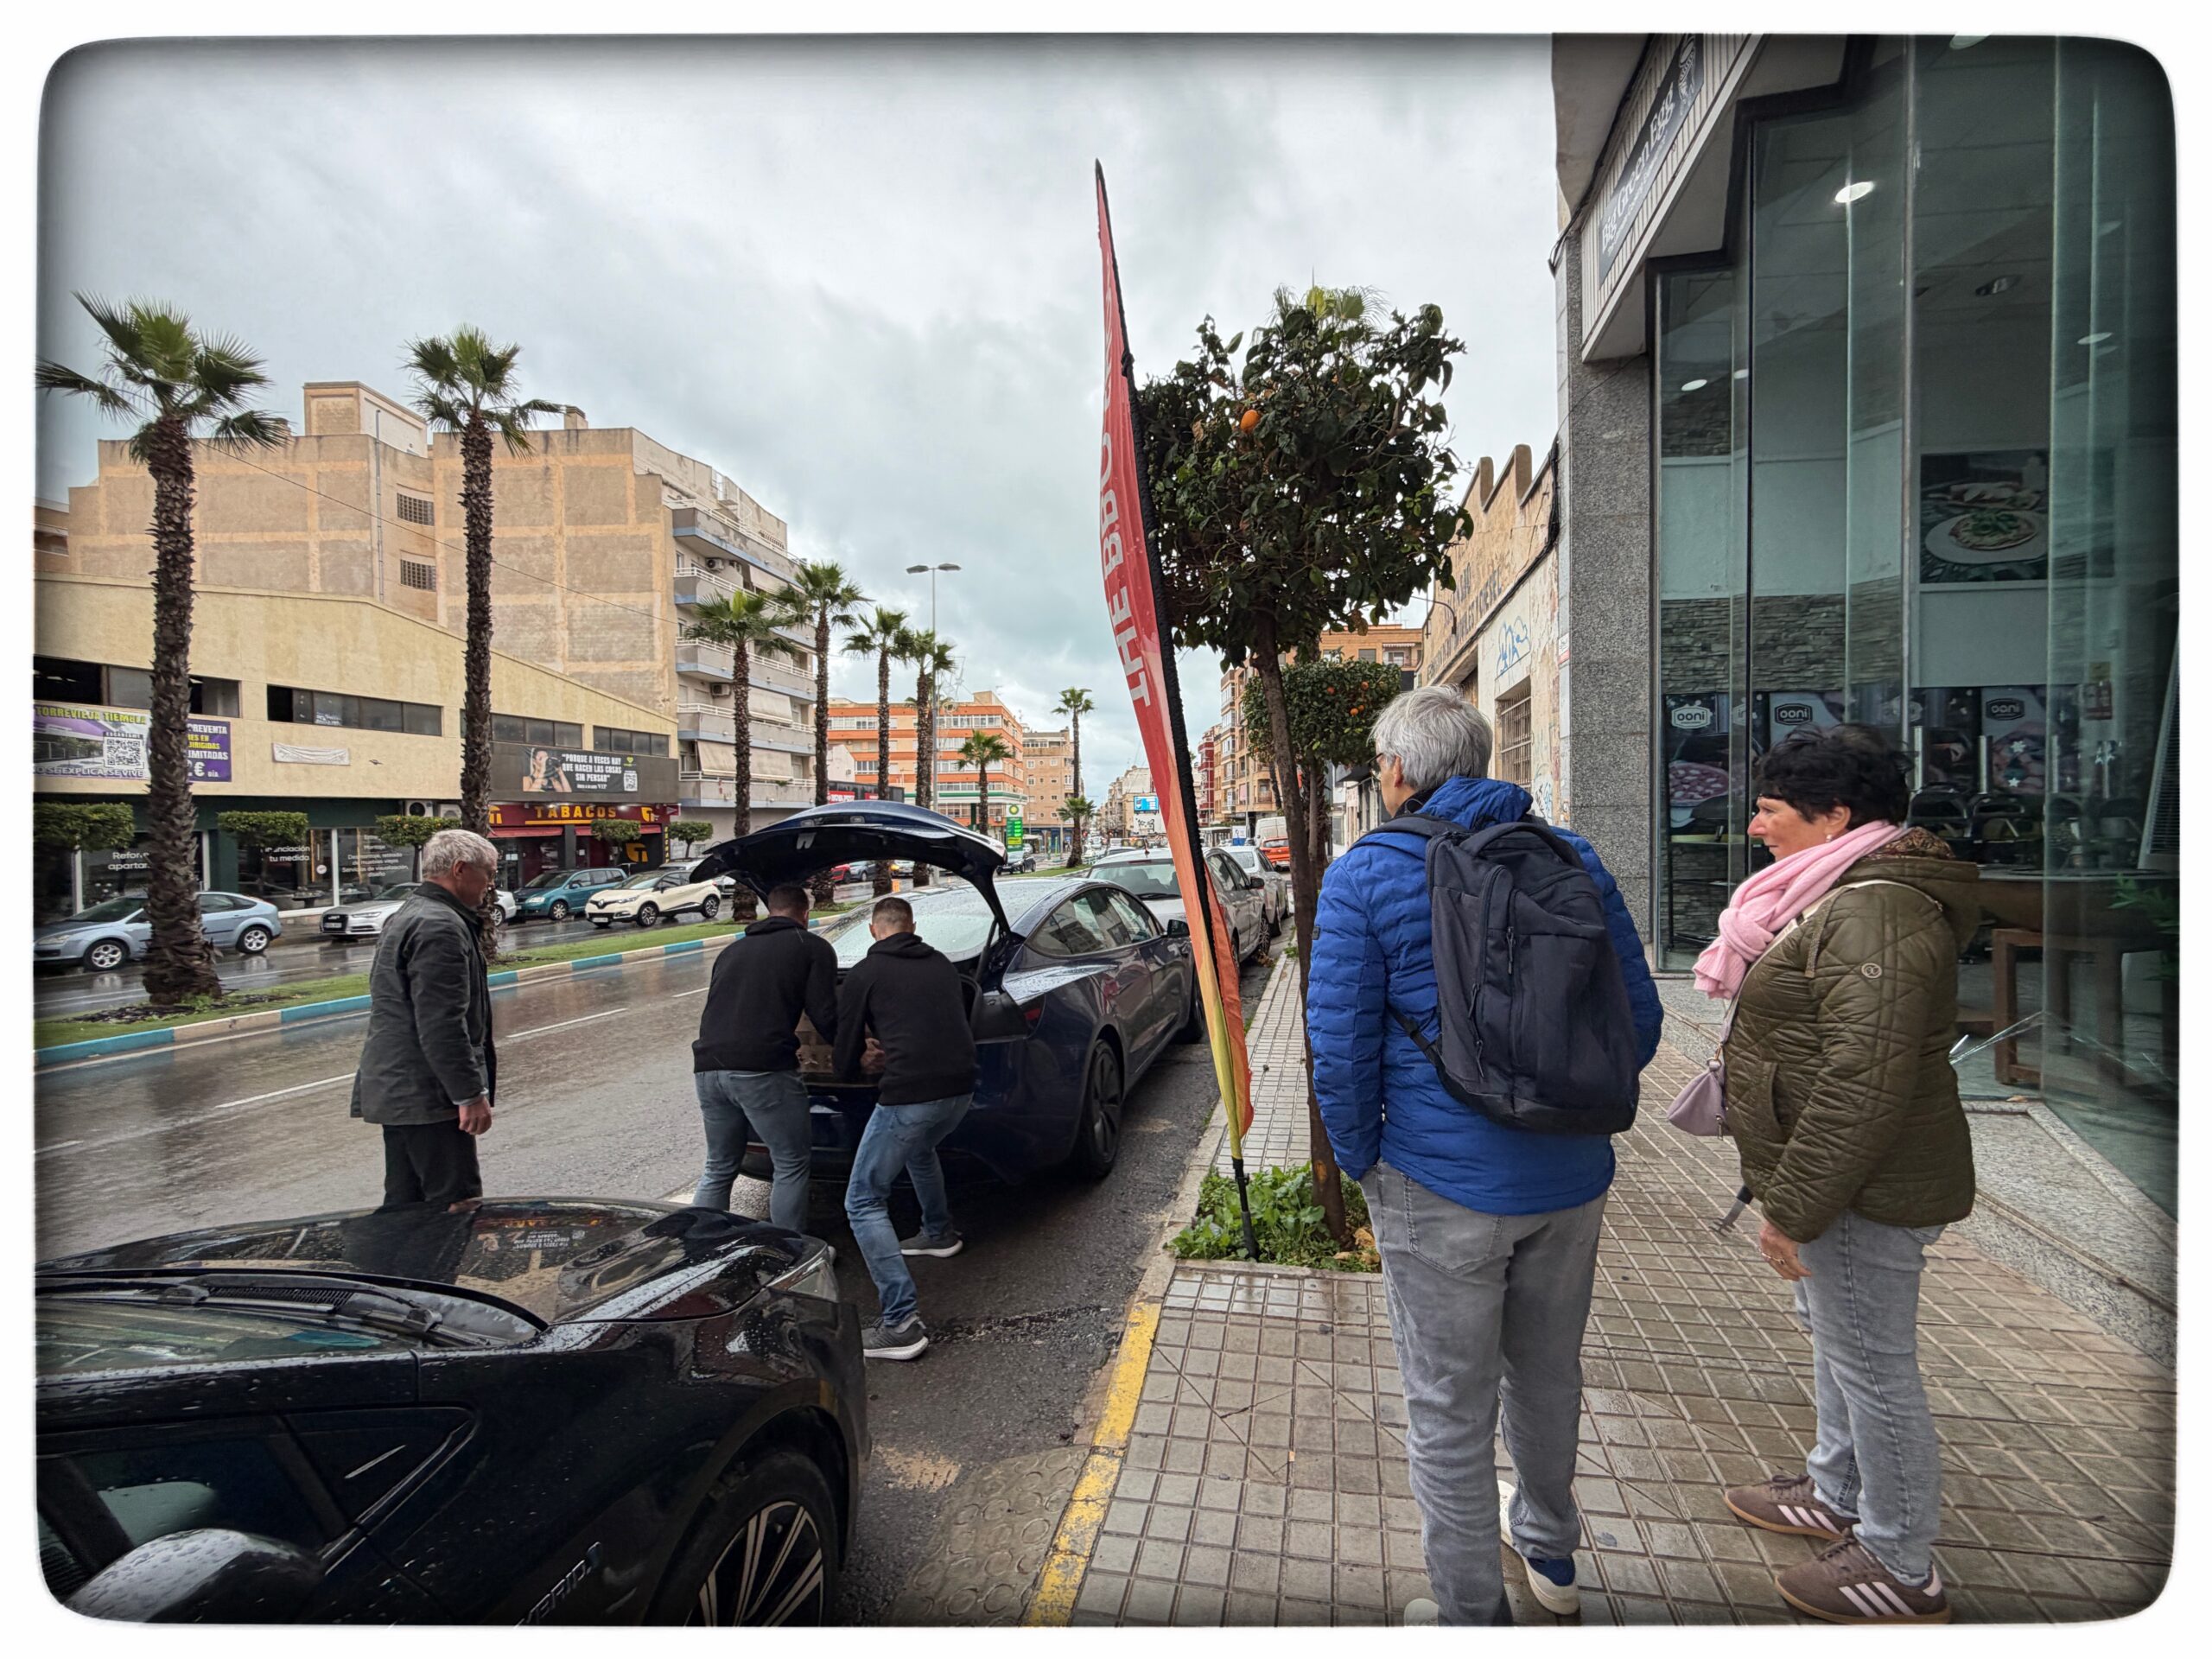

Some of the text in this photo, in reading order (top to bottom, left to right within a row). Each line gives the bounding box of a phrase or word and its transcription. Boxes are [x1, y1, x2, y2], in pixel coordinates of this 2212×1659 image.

[1618, 141, 1649, 218] Green
[1649, 82, 1675, 152] Egg
[1779, 709, 1808, 718] ooni
[1991, 704, 2019, 714] ooni
[36, 706, 146, 724] TORREVIEJA TIEMBLA
[1677, 712, 1705, 721] ooni
[188, 750, 228, 760] IMITADAS
[534, 805, 617, 818] TABACOS
